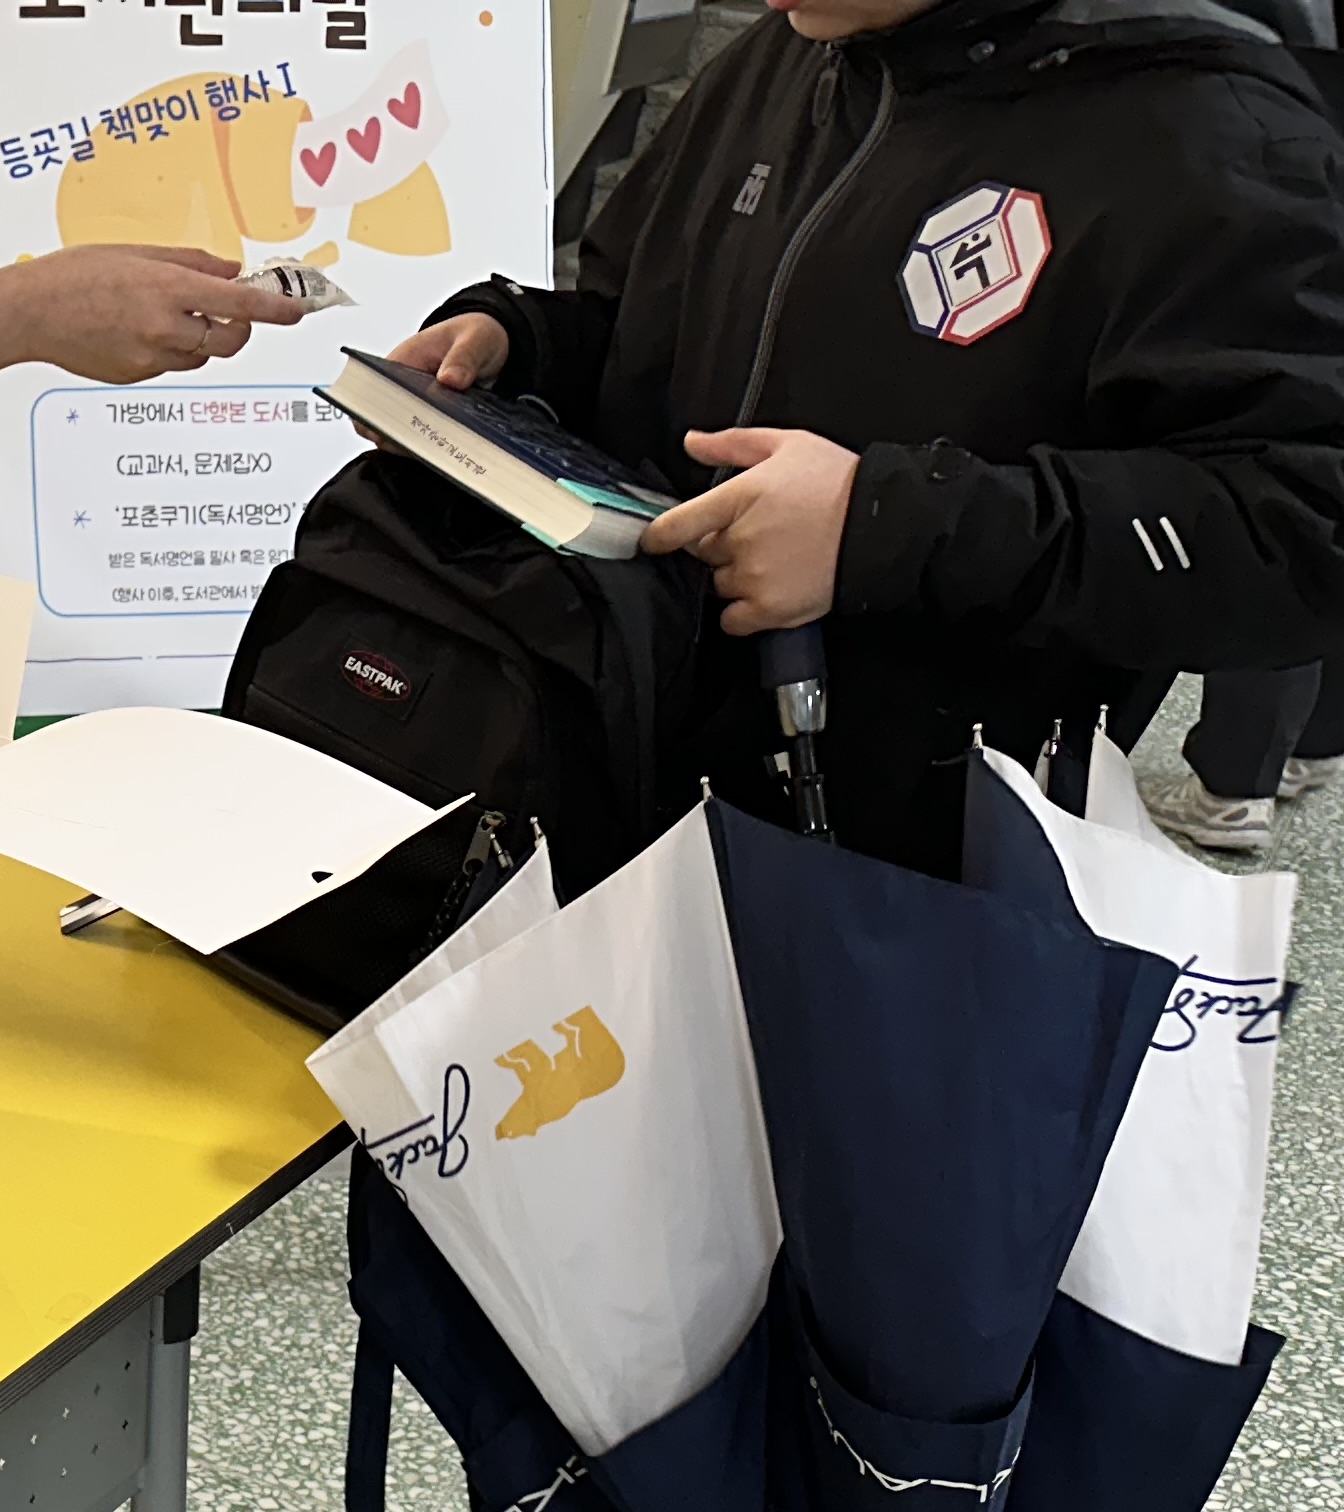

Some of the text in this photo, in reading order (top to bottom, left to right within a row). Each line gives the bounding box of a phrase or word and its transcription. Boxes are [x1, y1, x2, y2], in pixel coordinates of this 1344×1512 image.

[0, 61, 296, 178] 등굣길 책맞이 행사 I
[105, 400, 308, 425] 가방에서 단행본 도서를
[344, 656, 403, 695] EASTPAK
